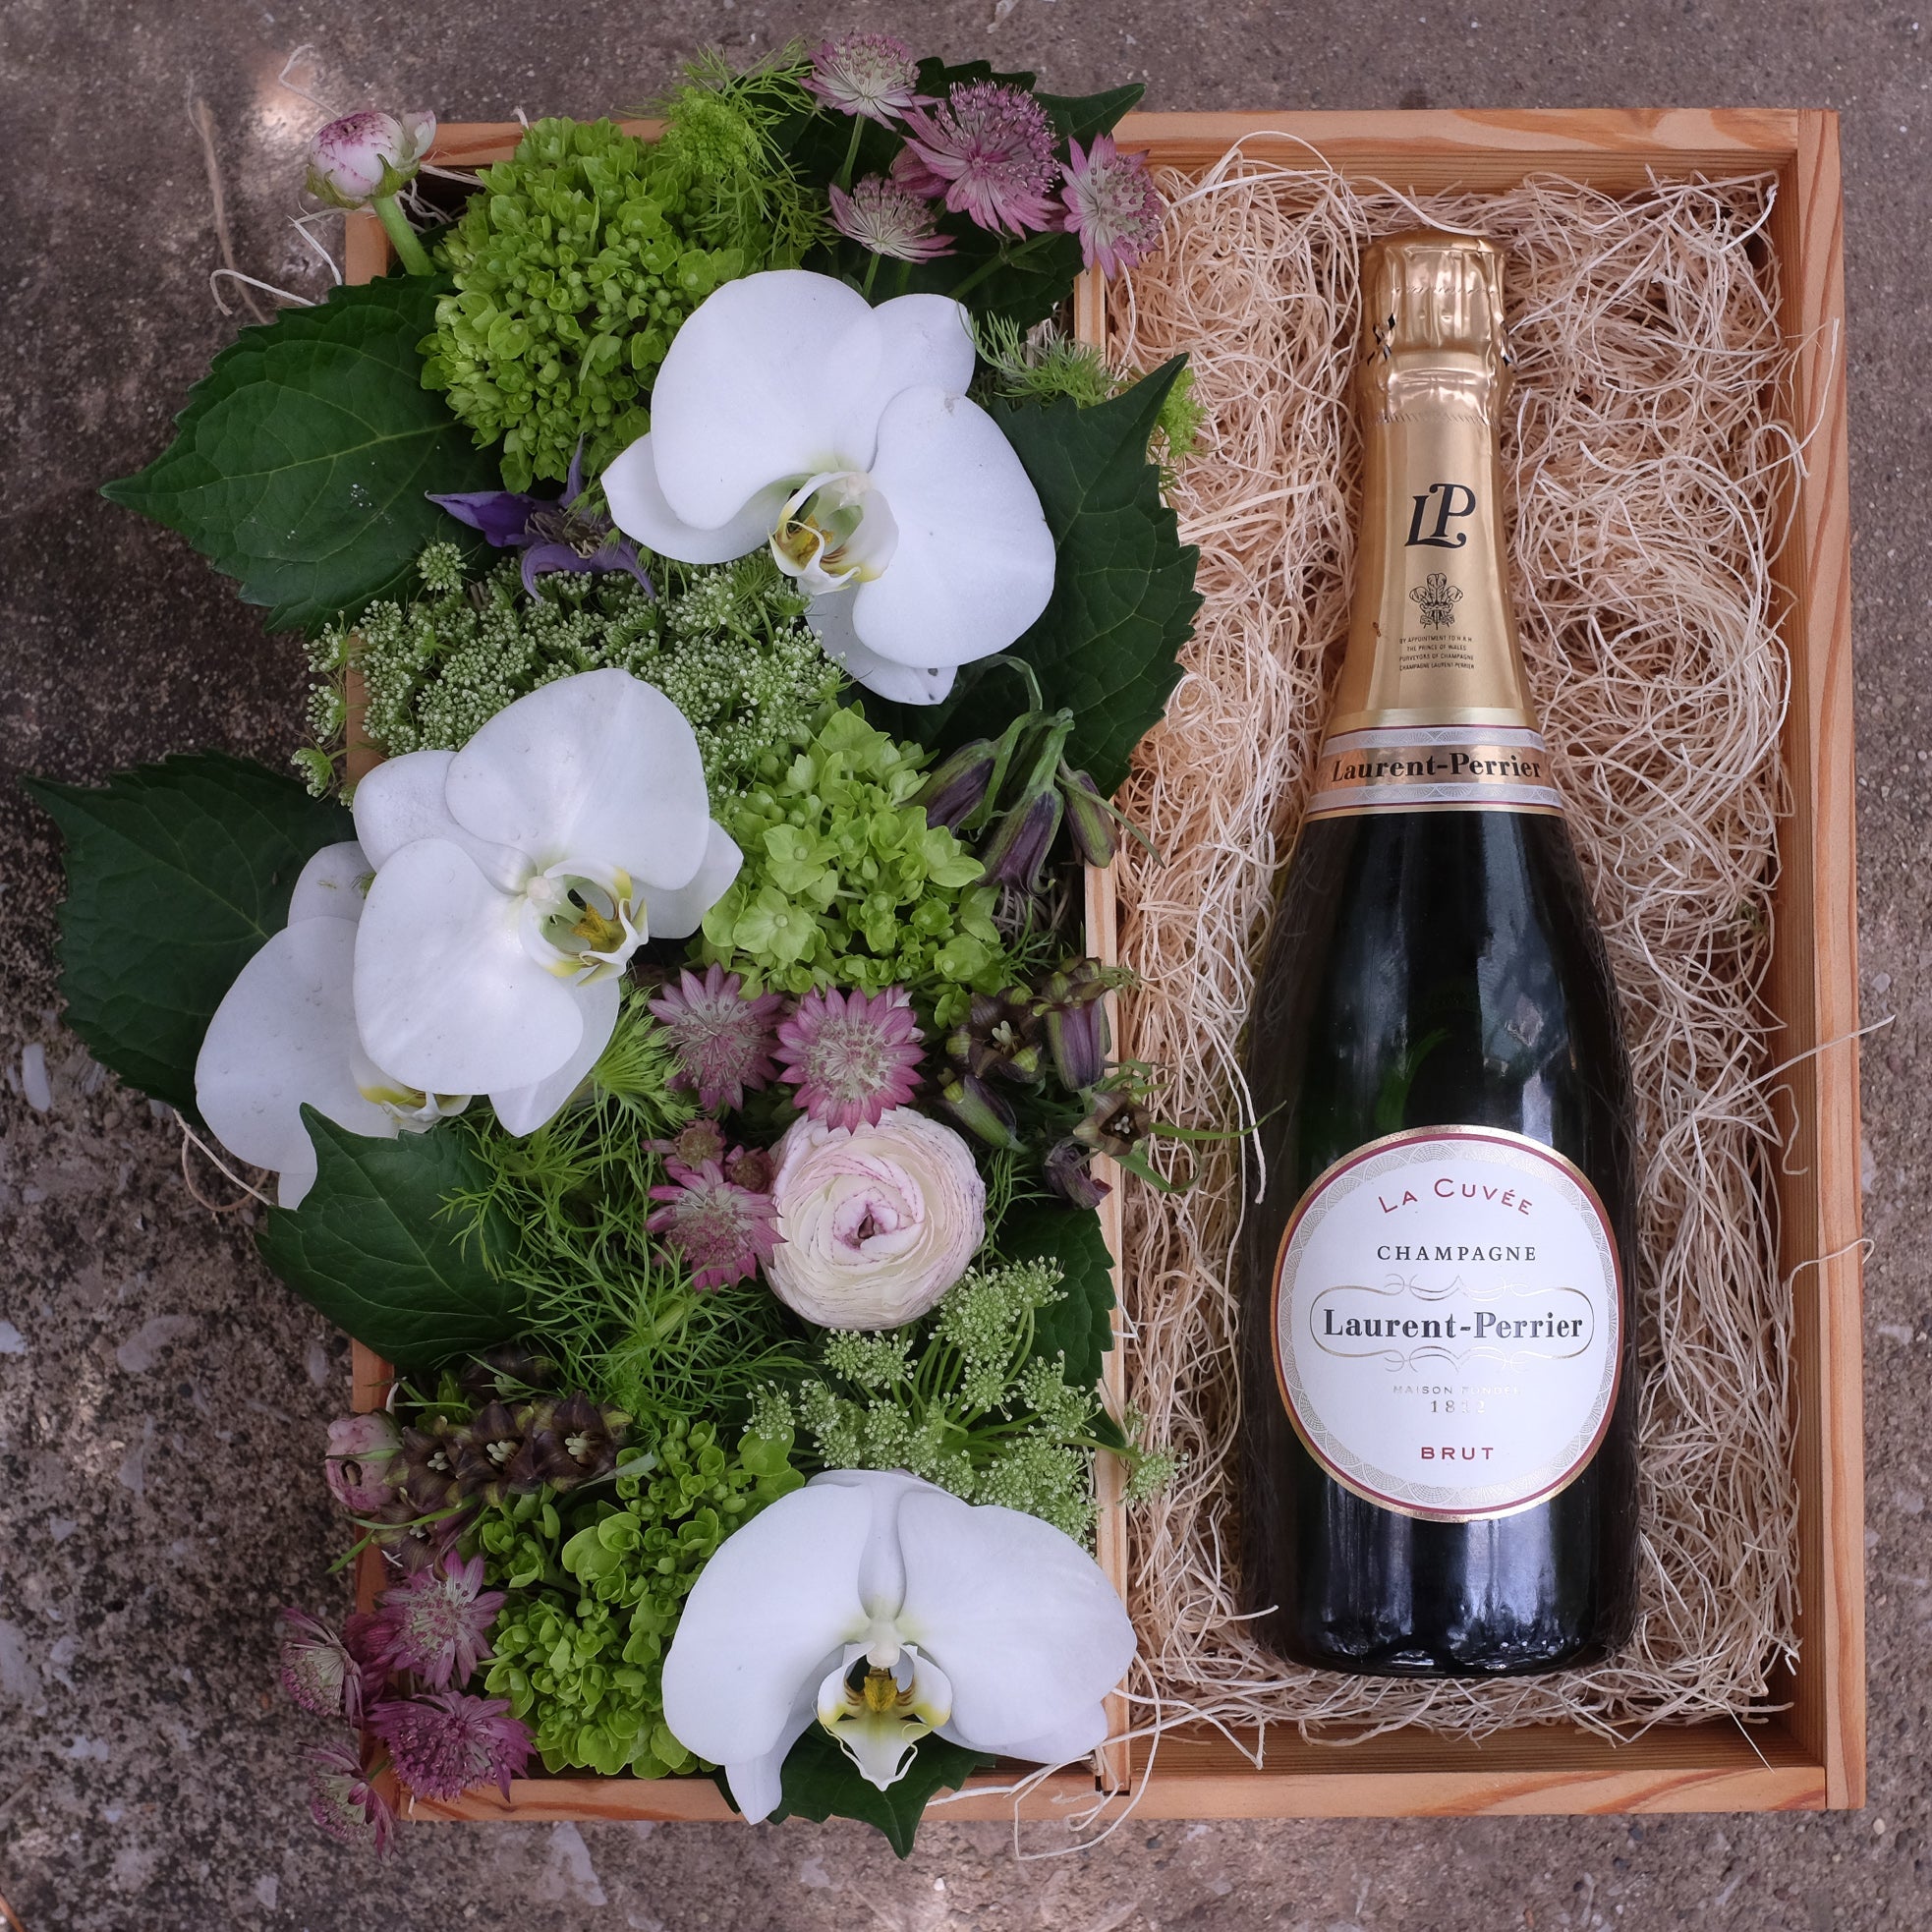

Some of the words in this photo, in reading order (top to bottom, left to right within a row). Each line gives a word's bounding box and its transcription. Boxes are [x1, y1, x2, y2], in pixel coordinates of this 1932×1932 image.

[1404, 483, 1476, 548] LP
[1399, 662, 1430, 671] CHAMPAGNE
[1332, 752, 1541, 782] Laurent-Perrier
[1377, 1245, 1536, 1262] CHAMPAGNE
[1323, 1308, 1584, 1339] Laurent-Perrier
[1392, 1386, 1453, 1394] MAISON
[1421, 1447, 1495, 1460] BRUT
